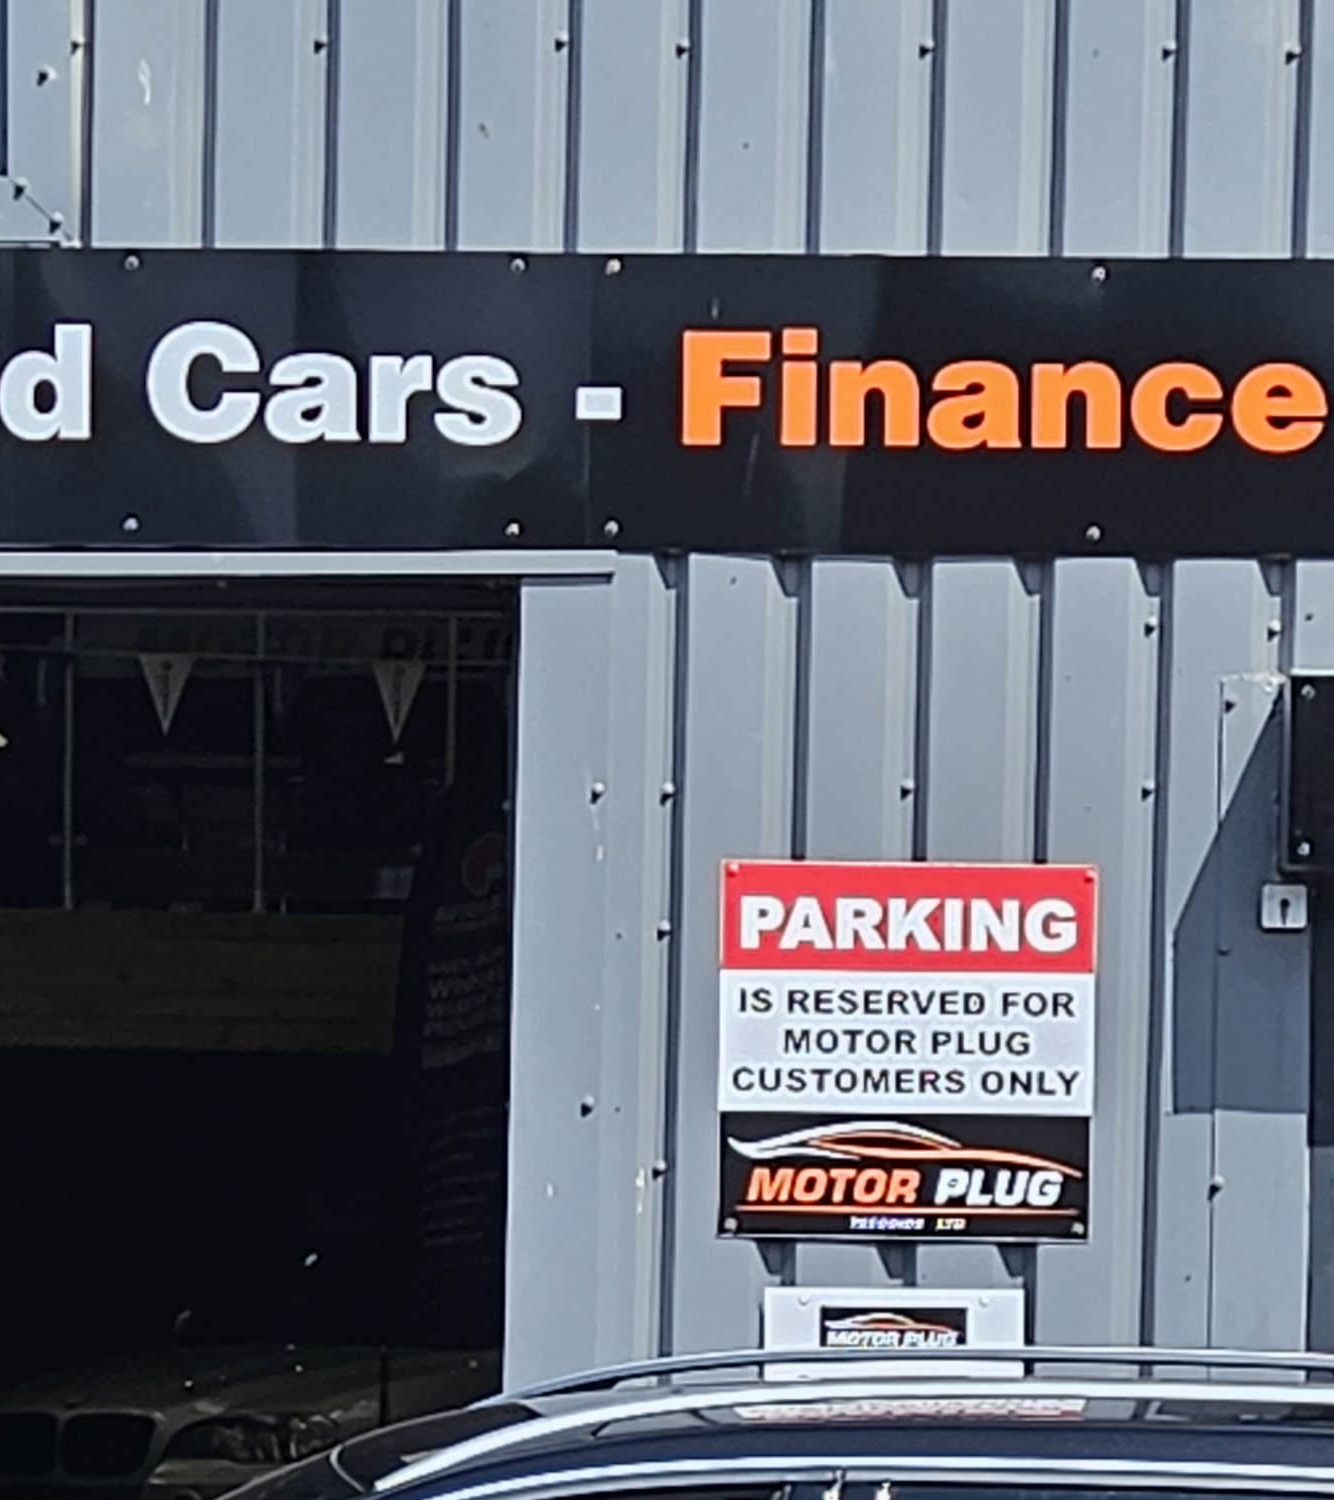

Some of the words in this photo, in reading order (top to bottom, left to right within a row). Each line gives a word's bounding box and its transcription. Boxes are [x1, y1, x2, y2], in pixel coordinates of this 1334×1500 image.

[146, 321, 522, 446] Cars
[575, 386, 622, 420] -
[682, 328, 1328, 452] Finance
[740, 894, 1078, 953] PARKING
[739, 988, 773, 1013] IS
[787, 989, 986, 1016] RESERVED
[1001, 992, 1075, 1018] FOR
[783, 1029, 917, 1055] MOTOR
[931, 1031, 1031, 1056] PLUG
[732, 1067, 966, 1094] CUSTOMERS
[981, 1071, 1080, 1096] ONLY
[746, 1167, 921, 1205] MOTOR
[934, 1168, 1064, 1207] PLUG
[826, 1330, 900, 1347] MOTOR
[902, 1331, 960, 1347] PLUG
